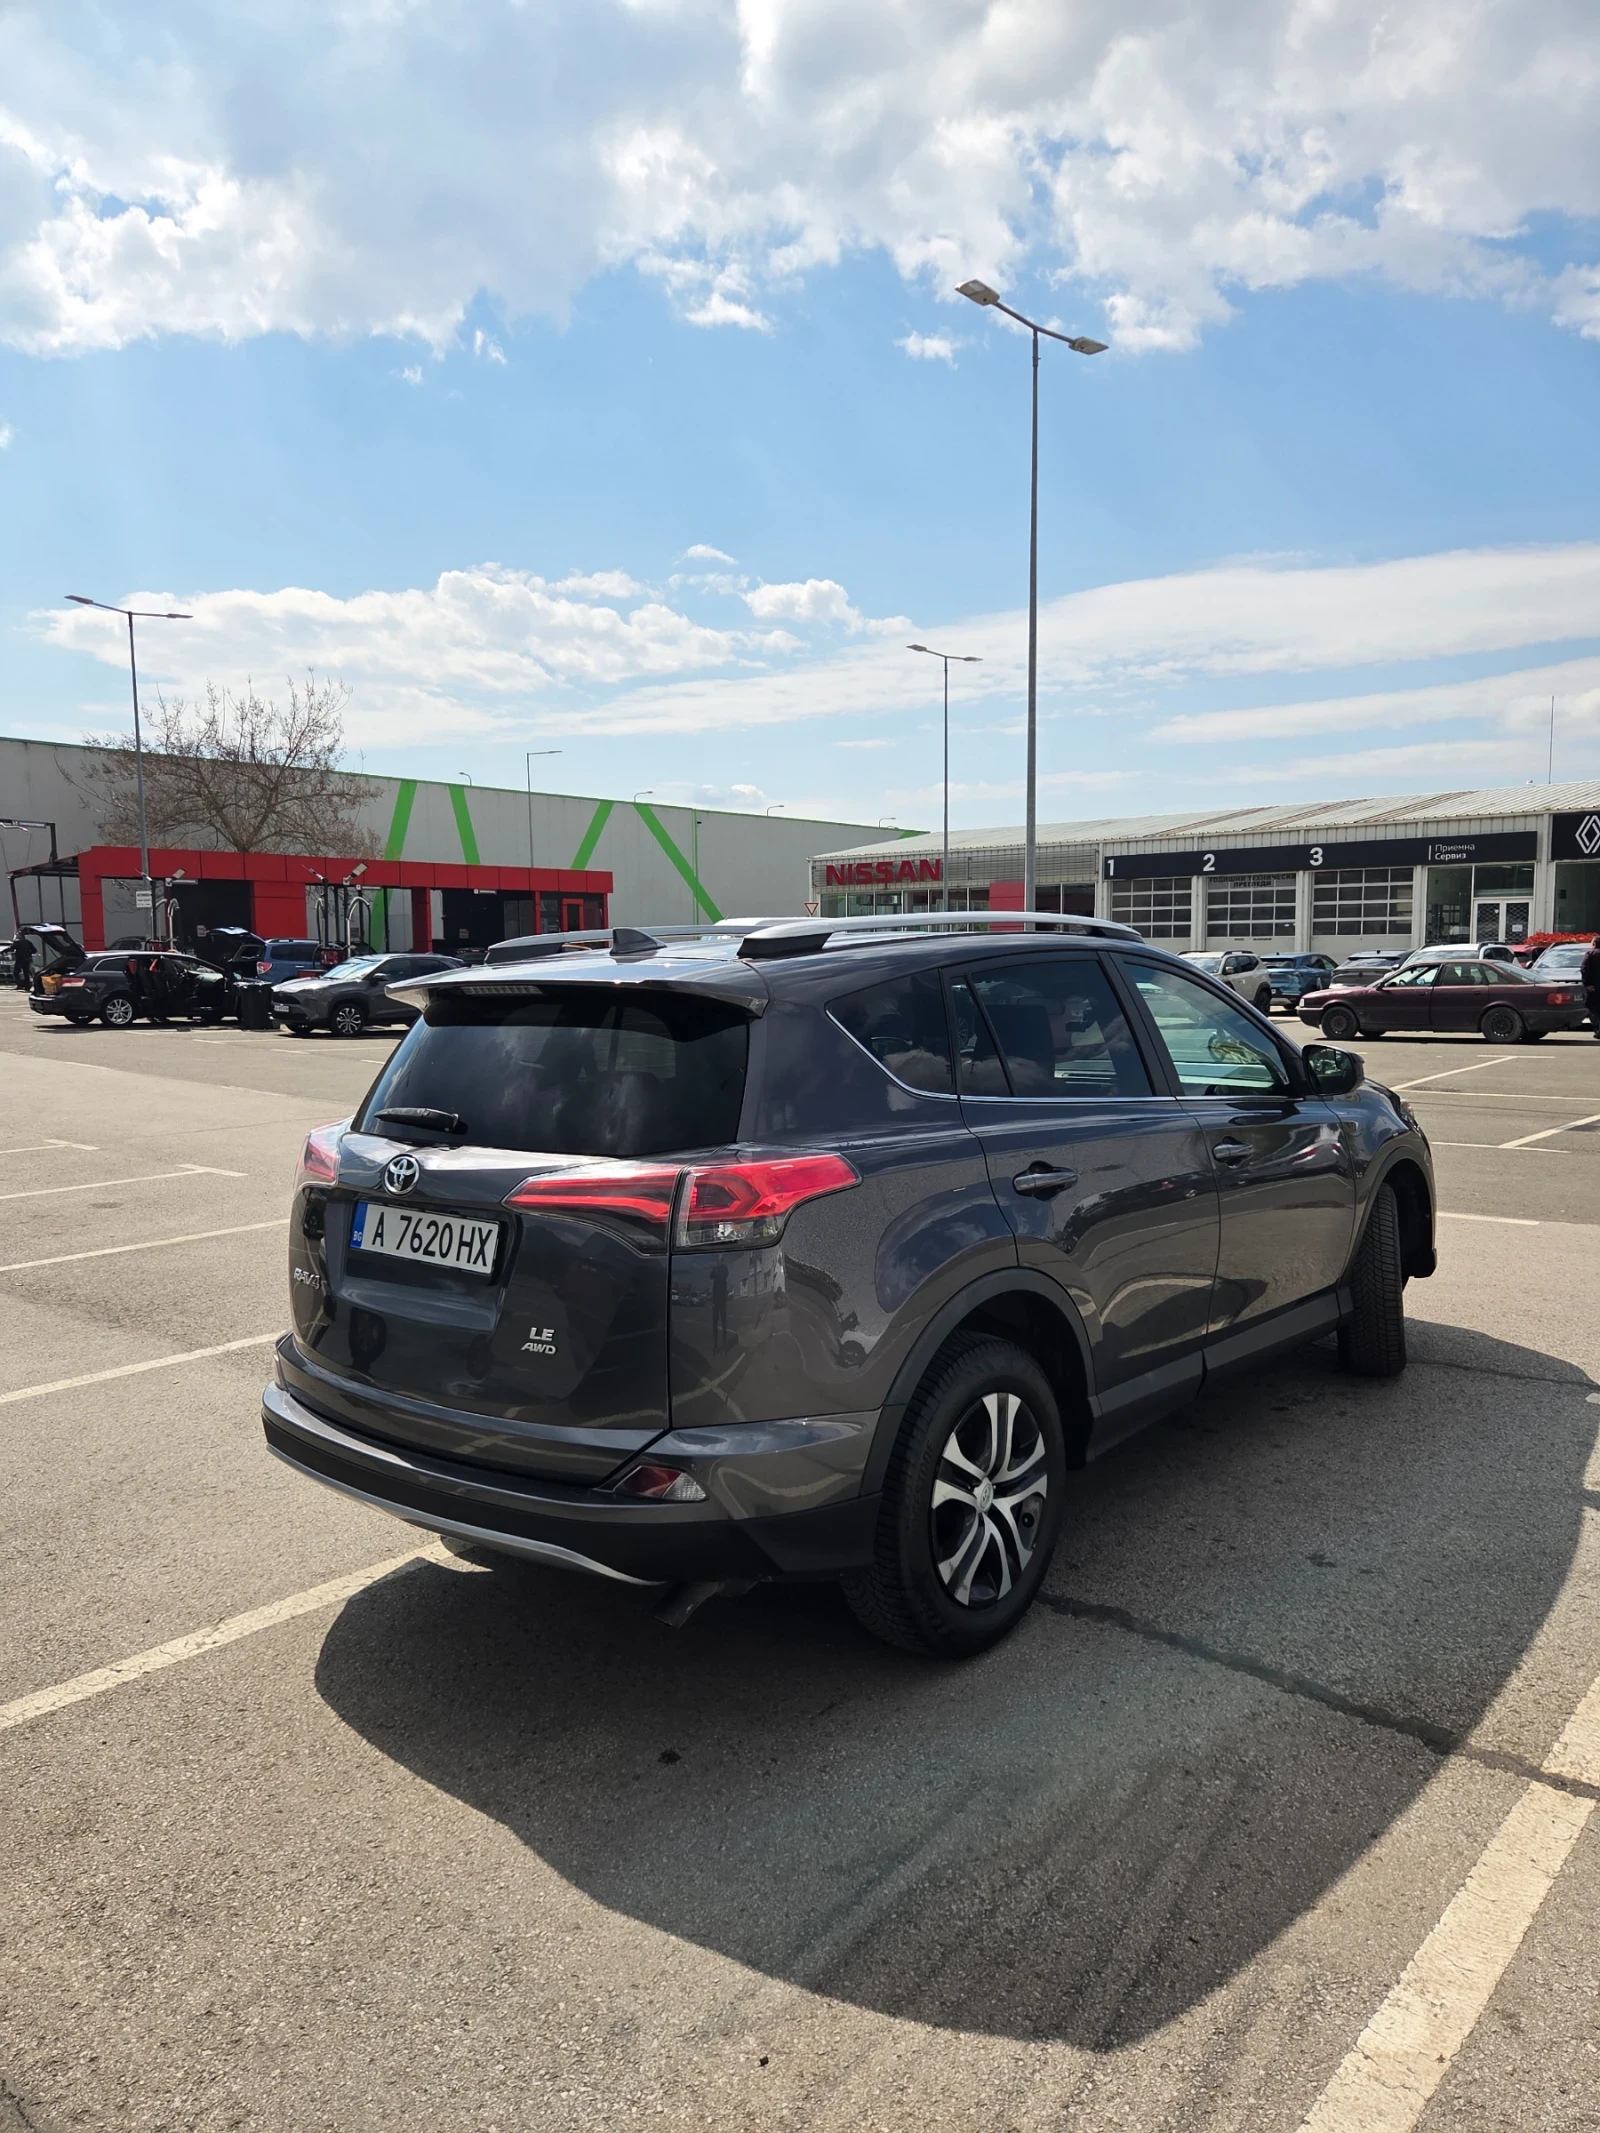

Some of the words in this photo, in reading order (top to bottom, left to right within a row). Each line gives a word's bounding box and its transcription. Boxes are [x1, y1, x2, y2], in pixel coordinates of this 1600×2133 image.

[1309, 847, 1324, 866] 3
[1434, 844, 1475, 853] Приемна
[1434, 852, 1467, 861] Сервиз
[1107, 859, 1115, 876] 1
[1203, 854, 1215, 872] 2
[826, 858, 941, 886] NISSAN
[353, 1230, 363, 1242] BG
[371, 1211, 385, 1248] A
[395, 1214, 454, 1259] 7620
[456, 1224, 493, 1267] HX
[529, 1326, 555, 1341] LE
[520, 1342, 557, 1355] AWD
